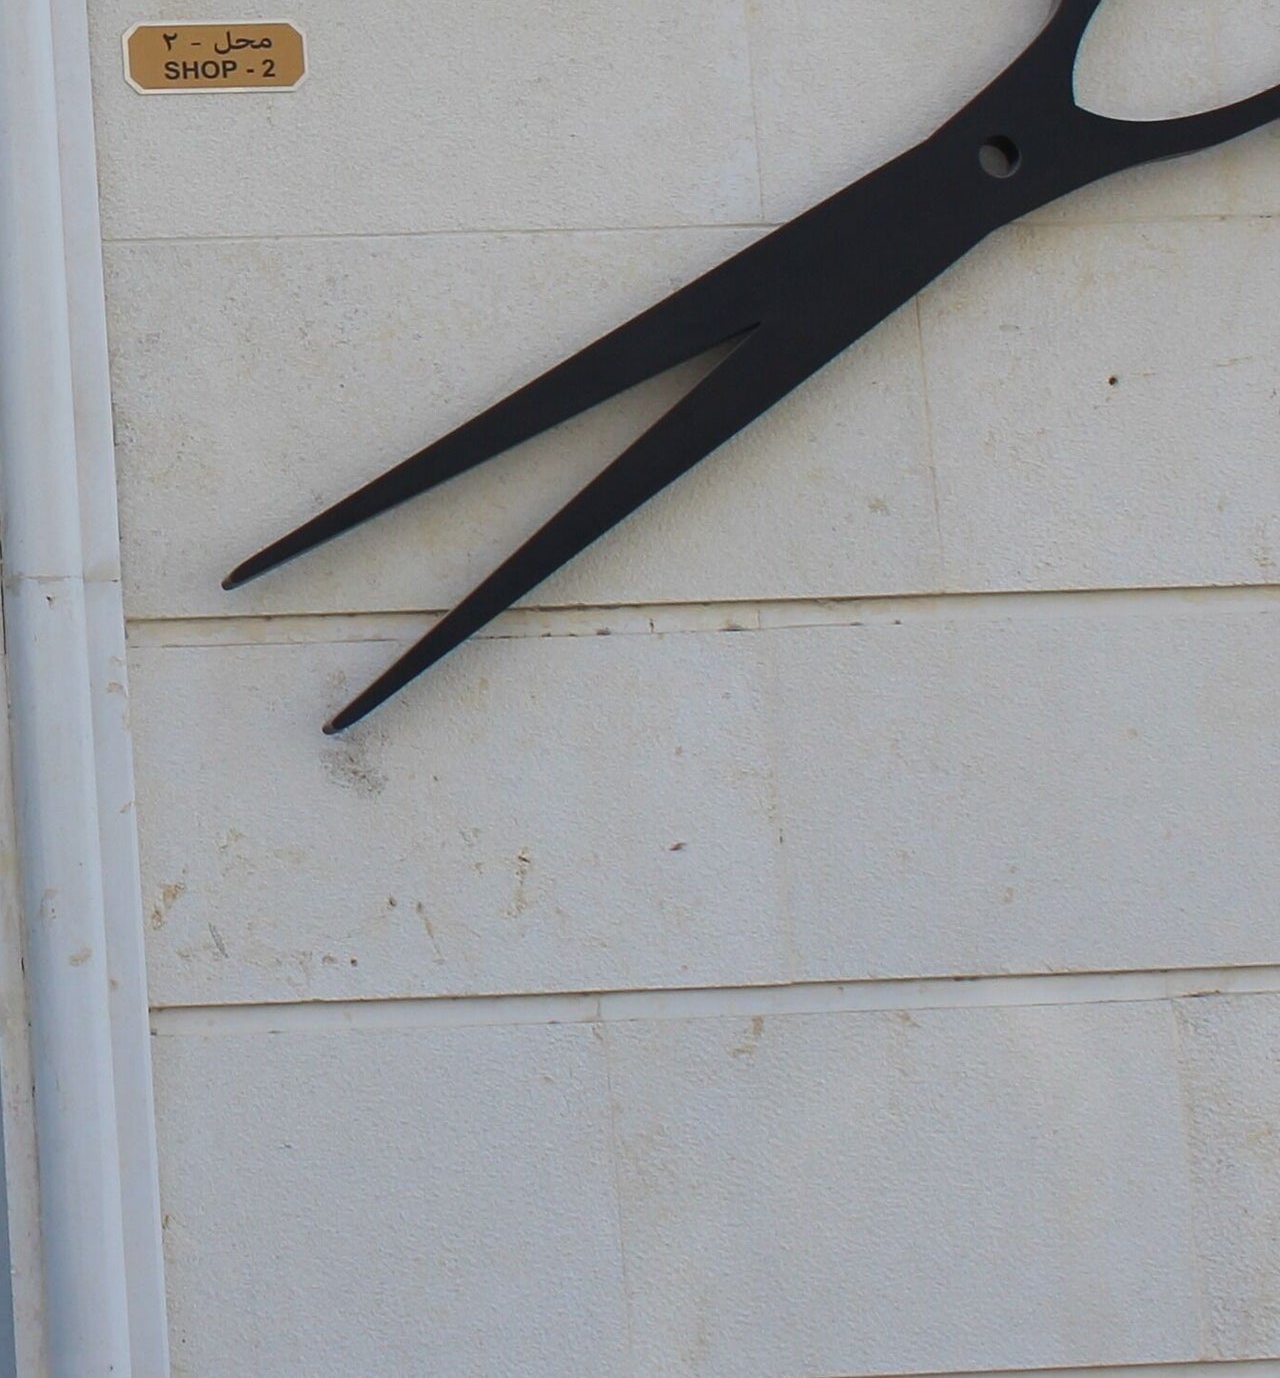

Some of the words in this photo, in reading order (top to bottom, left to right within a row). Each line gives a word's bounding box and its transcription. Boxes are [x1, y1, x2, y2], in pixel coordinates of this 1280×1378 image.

[162, 32, 178, 52] ٢
[213, 30, 274, 55] محل
[163, 59, 238, 81] SHOP
[261, 58, 276, 78] 2
